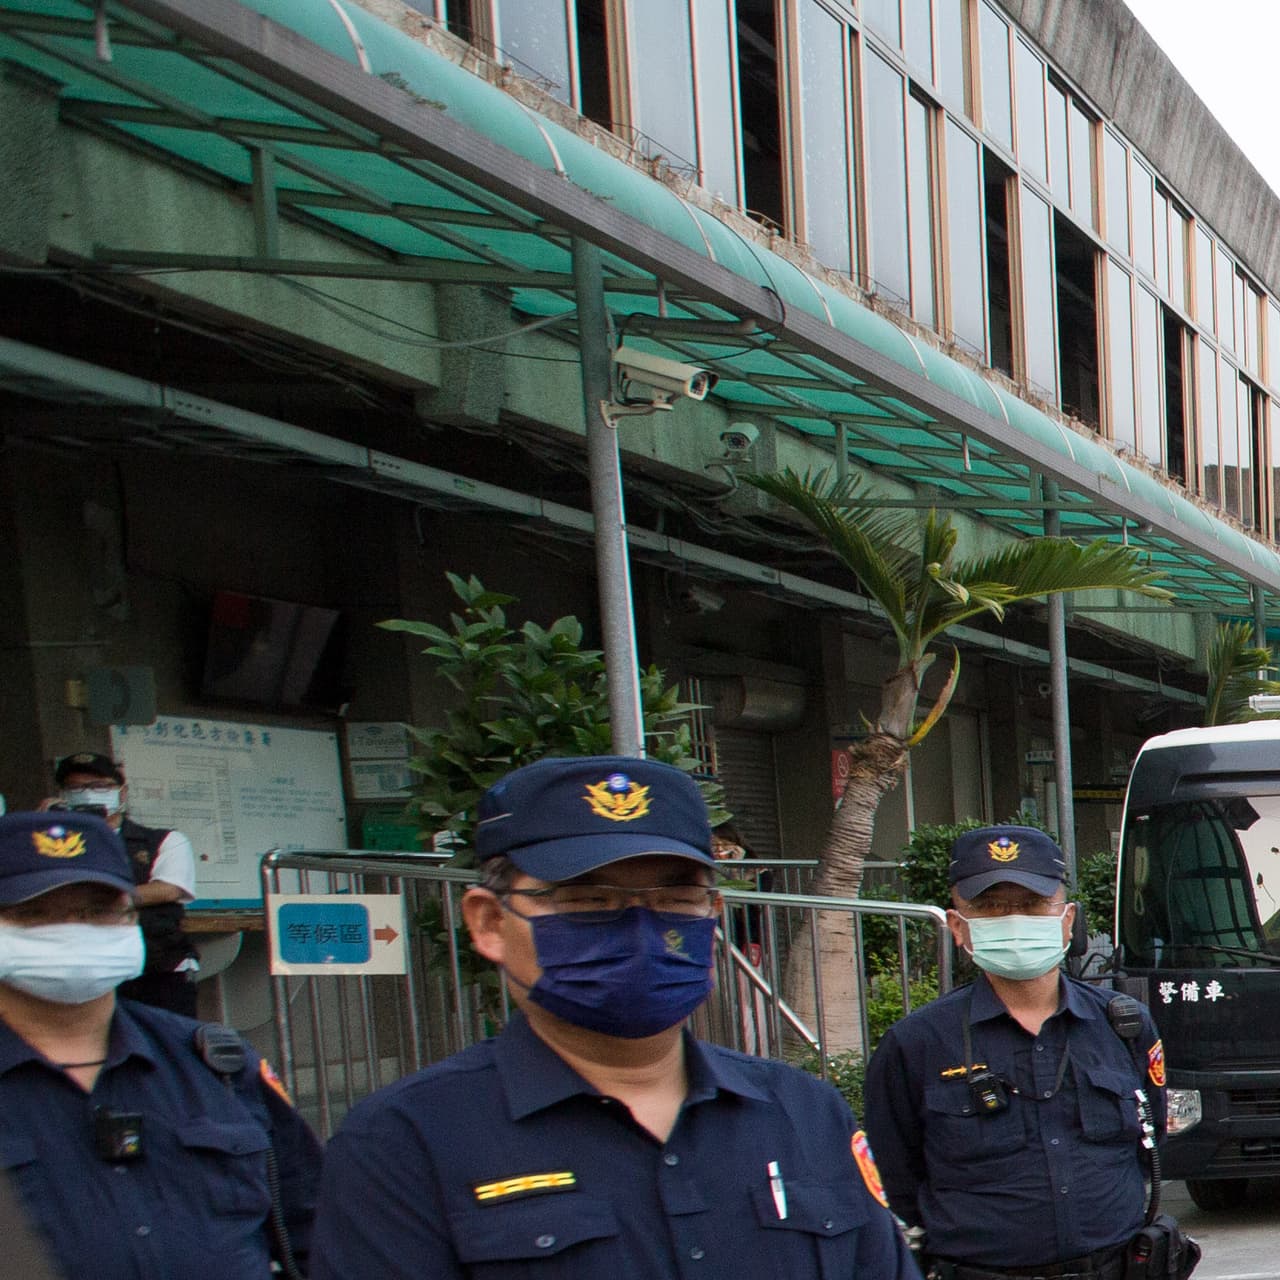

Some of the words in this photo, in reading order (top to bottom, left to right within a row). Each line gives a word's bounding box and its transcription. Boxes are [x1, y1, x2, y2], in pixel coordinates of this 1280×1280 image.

[287, 923, 364, 944] 等候區
[1159, 980, 1225, 1004] 警備車
